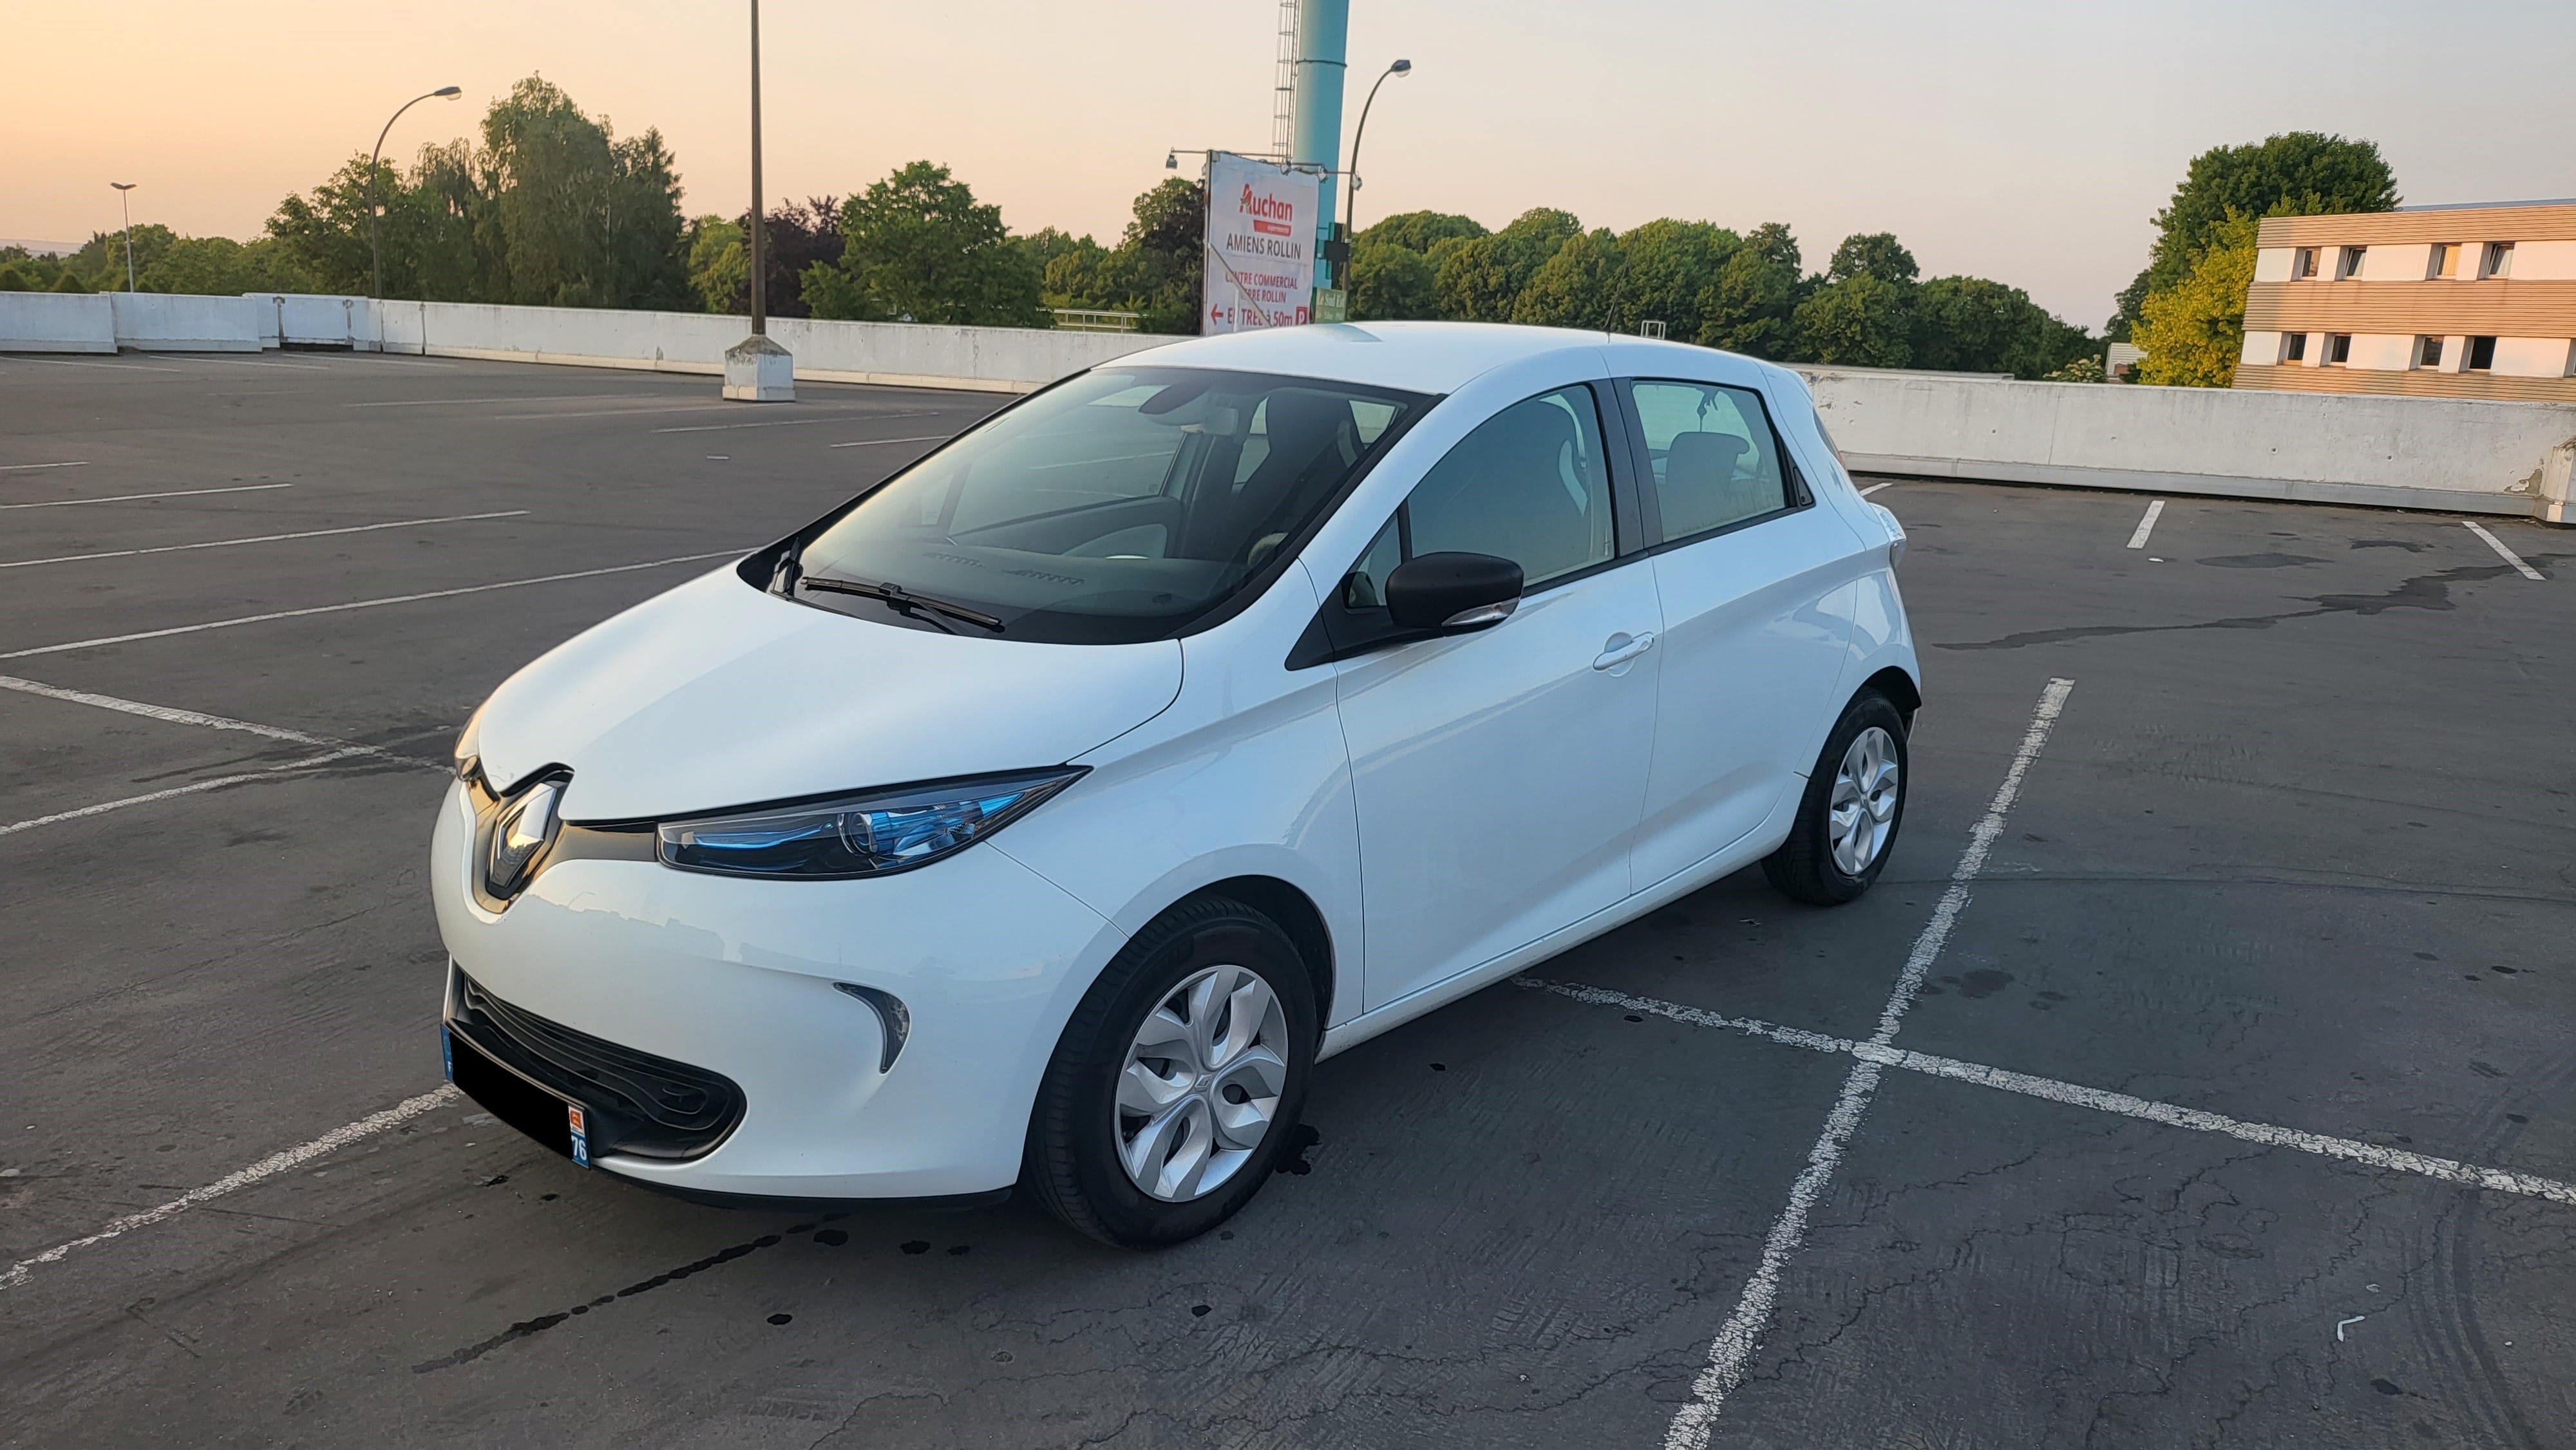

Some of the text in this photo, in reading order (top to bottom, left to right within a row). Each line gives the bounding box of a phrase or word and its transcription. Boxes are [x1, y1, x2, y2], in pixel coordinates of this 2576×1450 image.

[1239, 183, 1293, 222] Auchan
[1226, 232, 1302, 259] AMIENS ROLLIN
[1226, 271, 1298, 290] CNTRE COMMERCIAL
[1262, 290, 1287, 303] ROLLIN
[1273, 310, 1293, 327] 50m
[571, 1135, 587, 1160] 76
